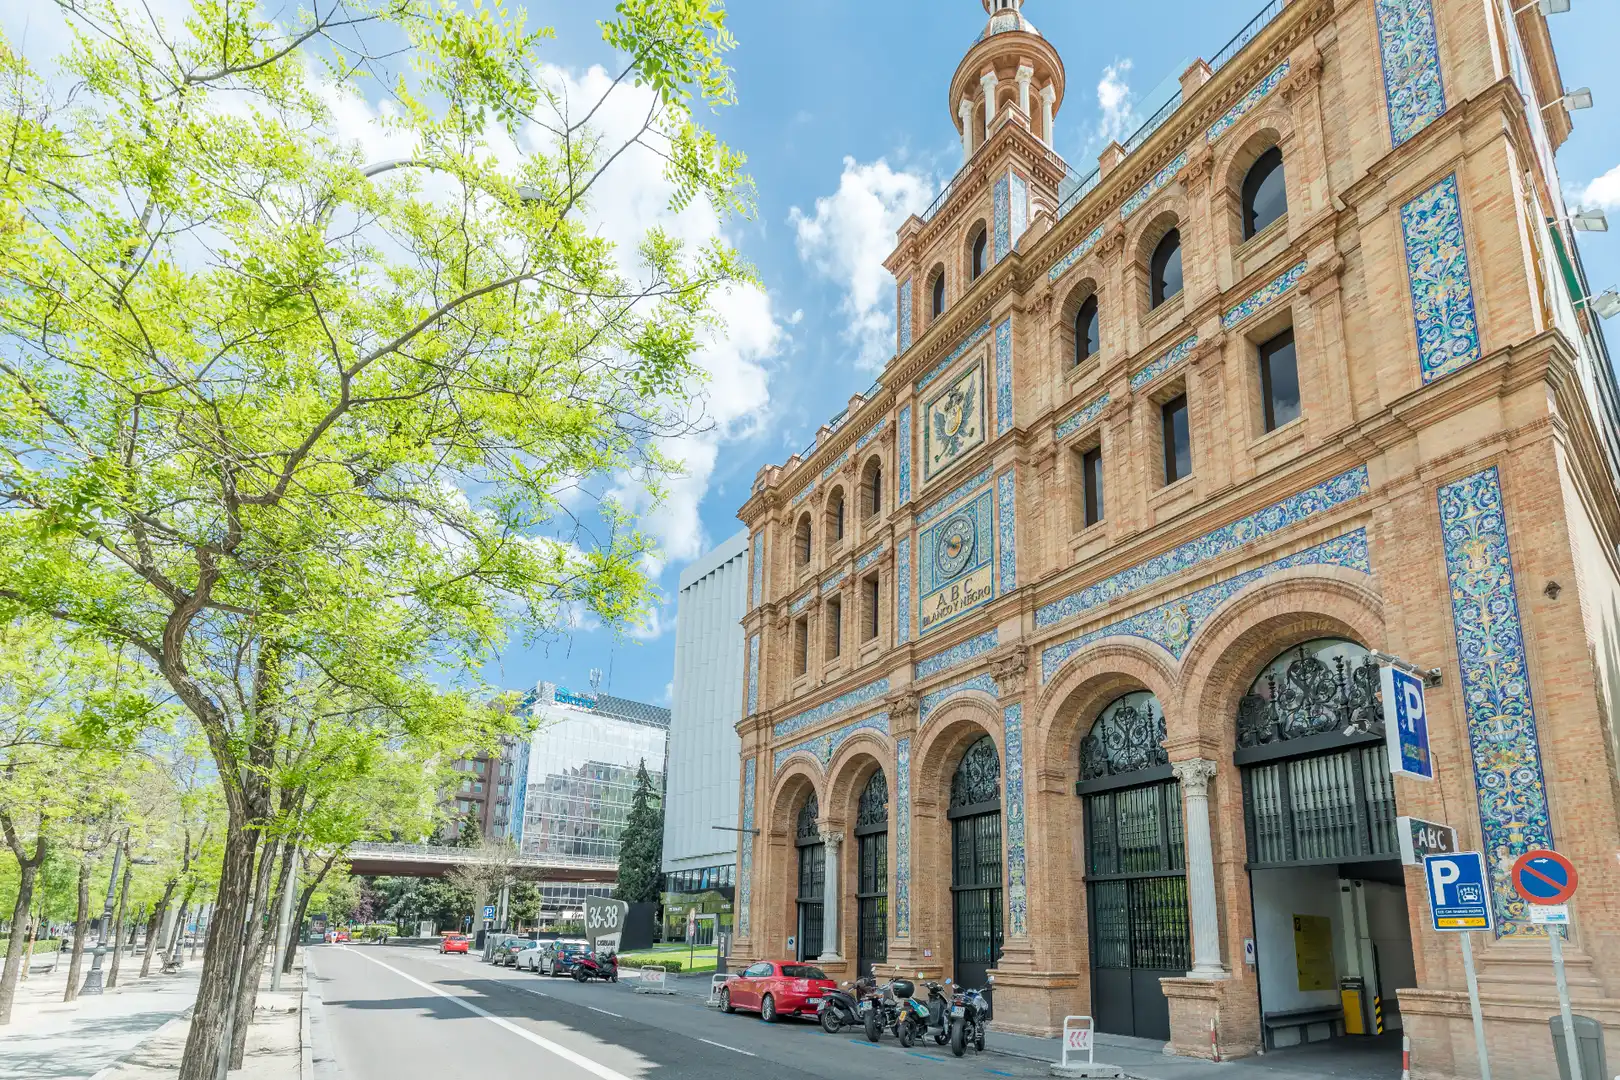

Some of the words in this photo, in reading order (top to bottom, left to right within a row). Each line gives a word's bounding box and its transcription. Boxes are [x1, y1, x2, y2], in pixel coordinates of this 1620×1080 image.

[923, 604, 953, 627] BLANCO
[953, 600, 959, 611] Y
[960, 585, 991, 609] NEGRO
[1403, 681, 1423, 733] P
[1418, 827, 1447, 851] ABC
[1430, 860, 1460, 906] P
[588, 904, 618, 929] 36-38
